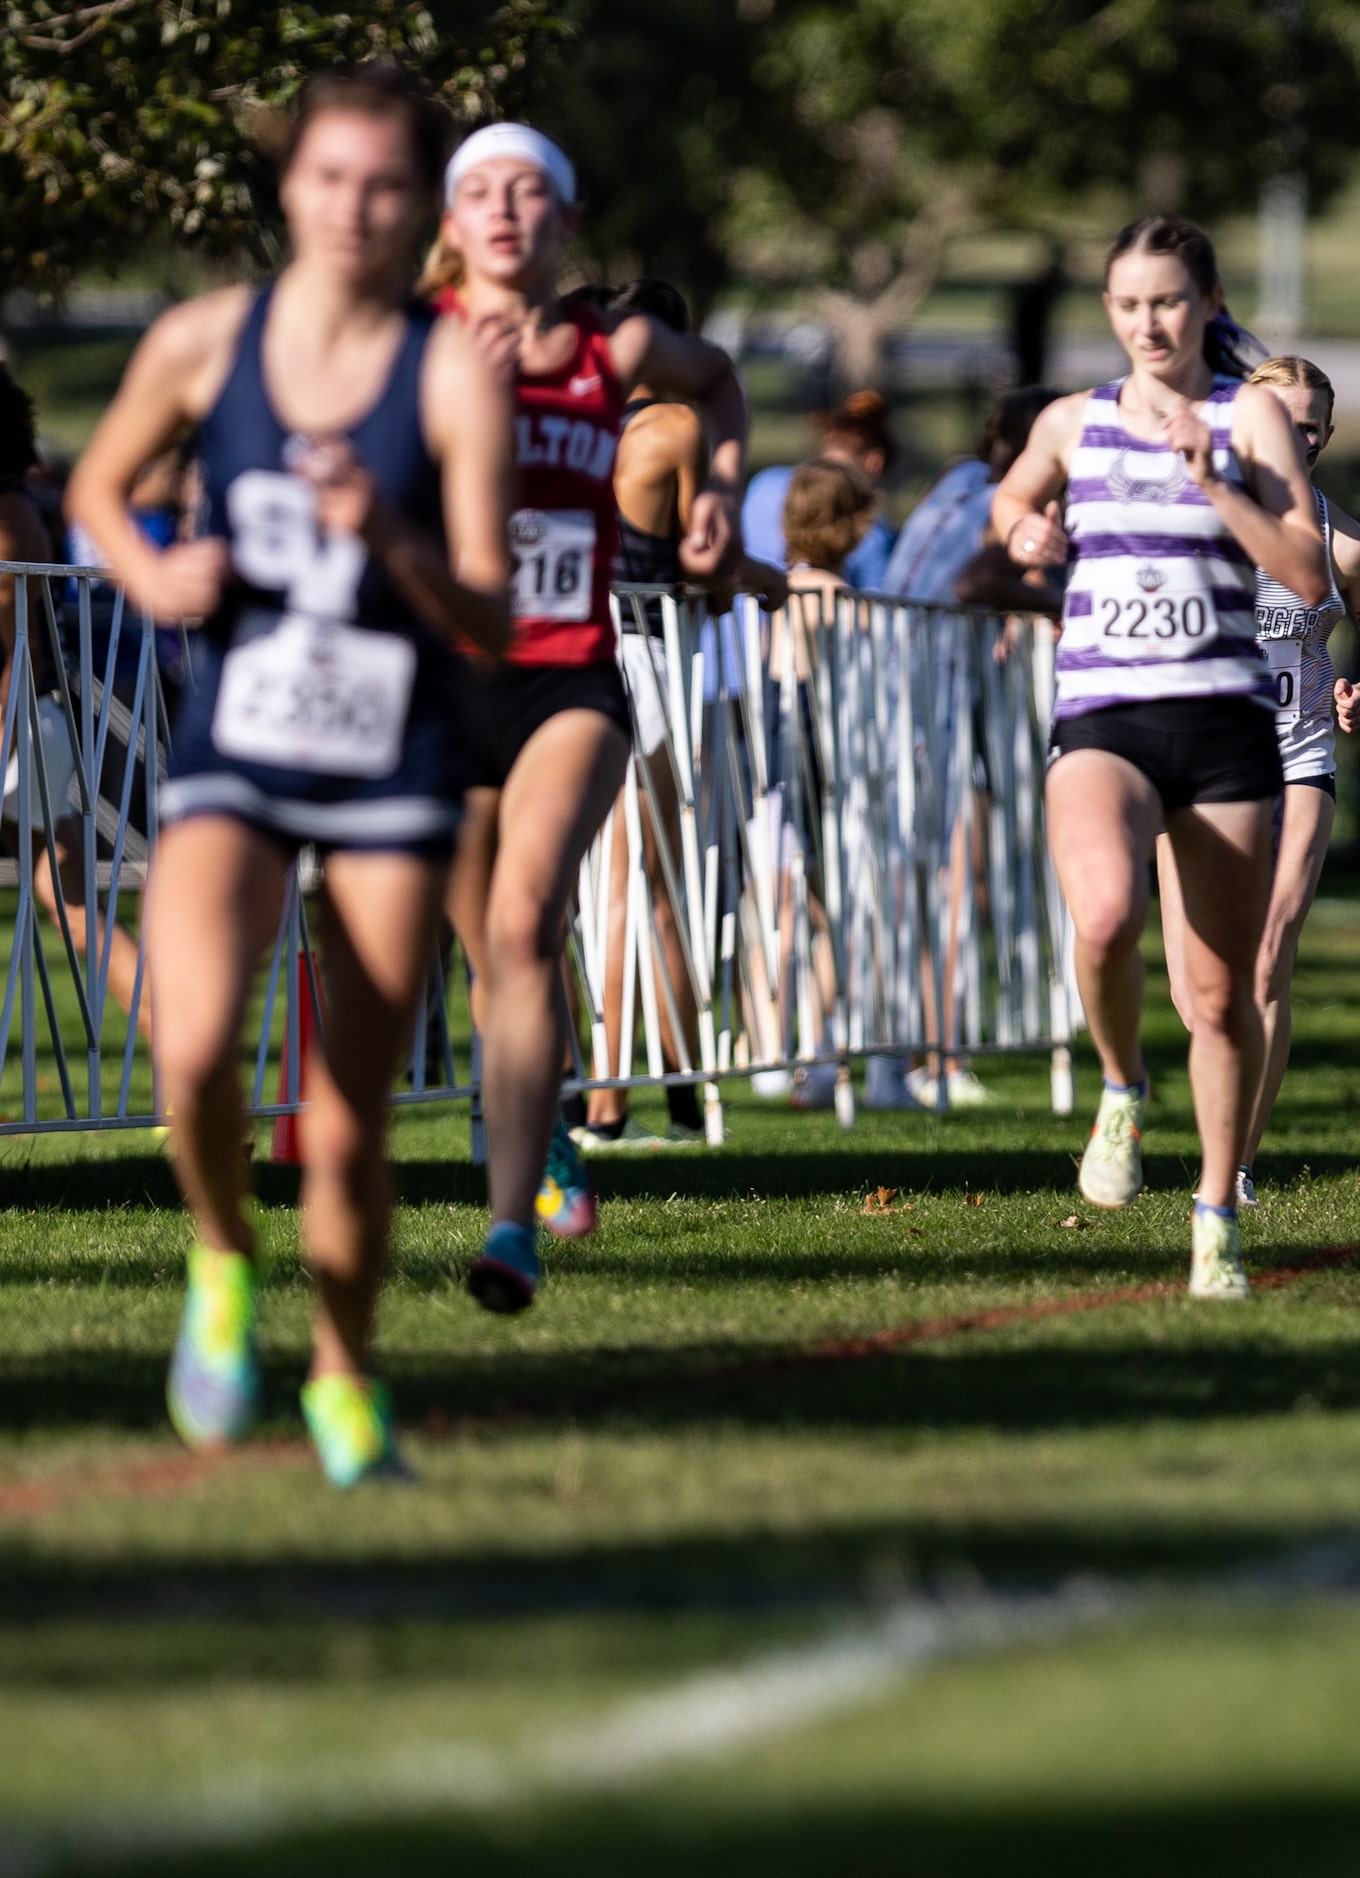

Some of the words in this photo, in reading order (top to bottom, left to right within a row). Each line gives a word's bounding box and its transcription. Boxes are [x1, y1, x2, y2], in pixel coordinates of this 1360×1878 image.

[515, 413, 617, 480] LTON
[1101, 597, 1205, 638] 2230
[1255, 606, 1321, 640] RGER
